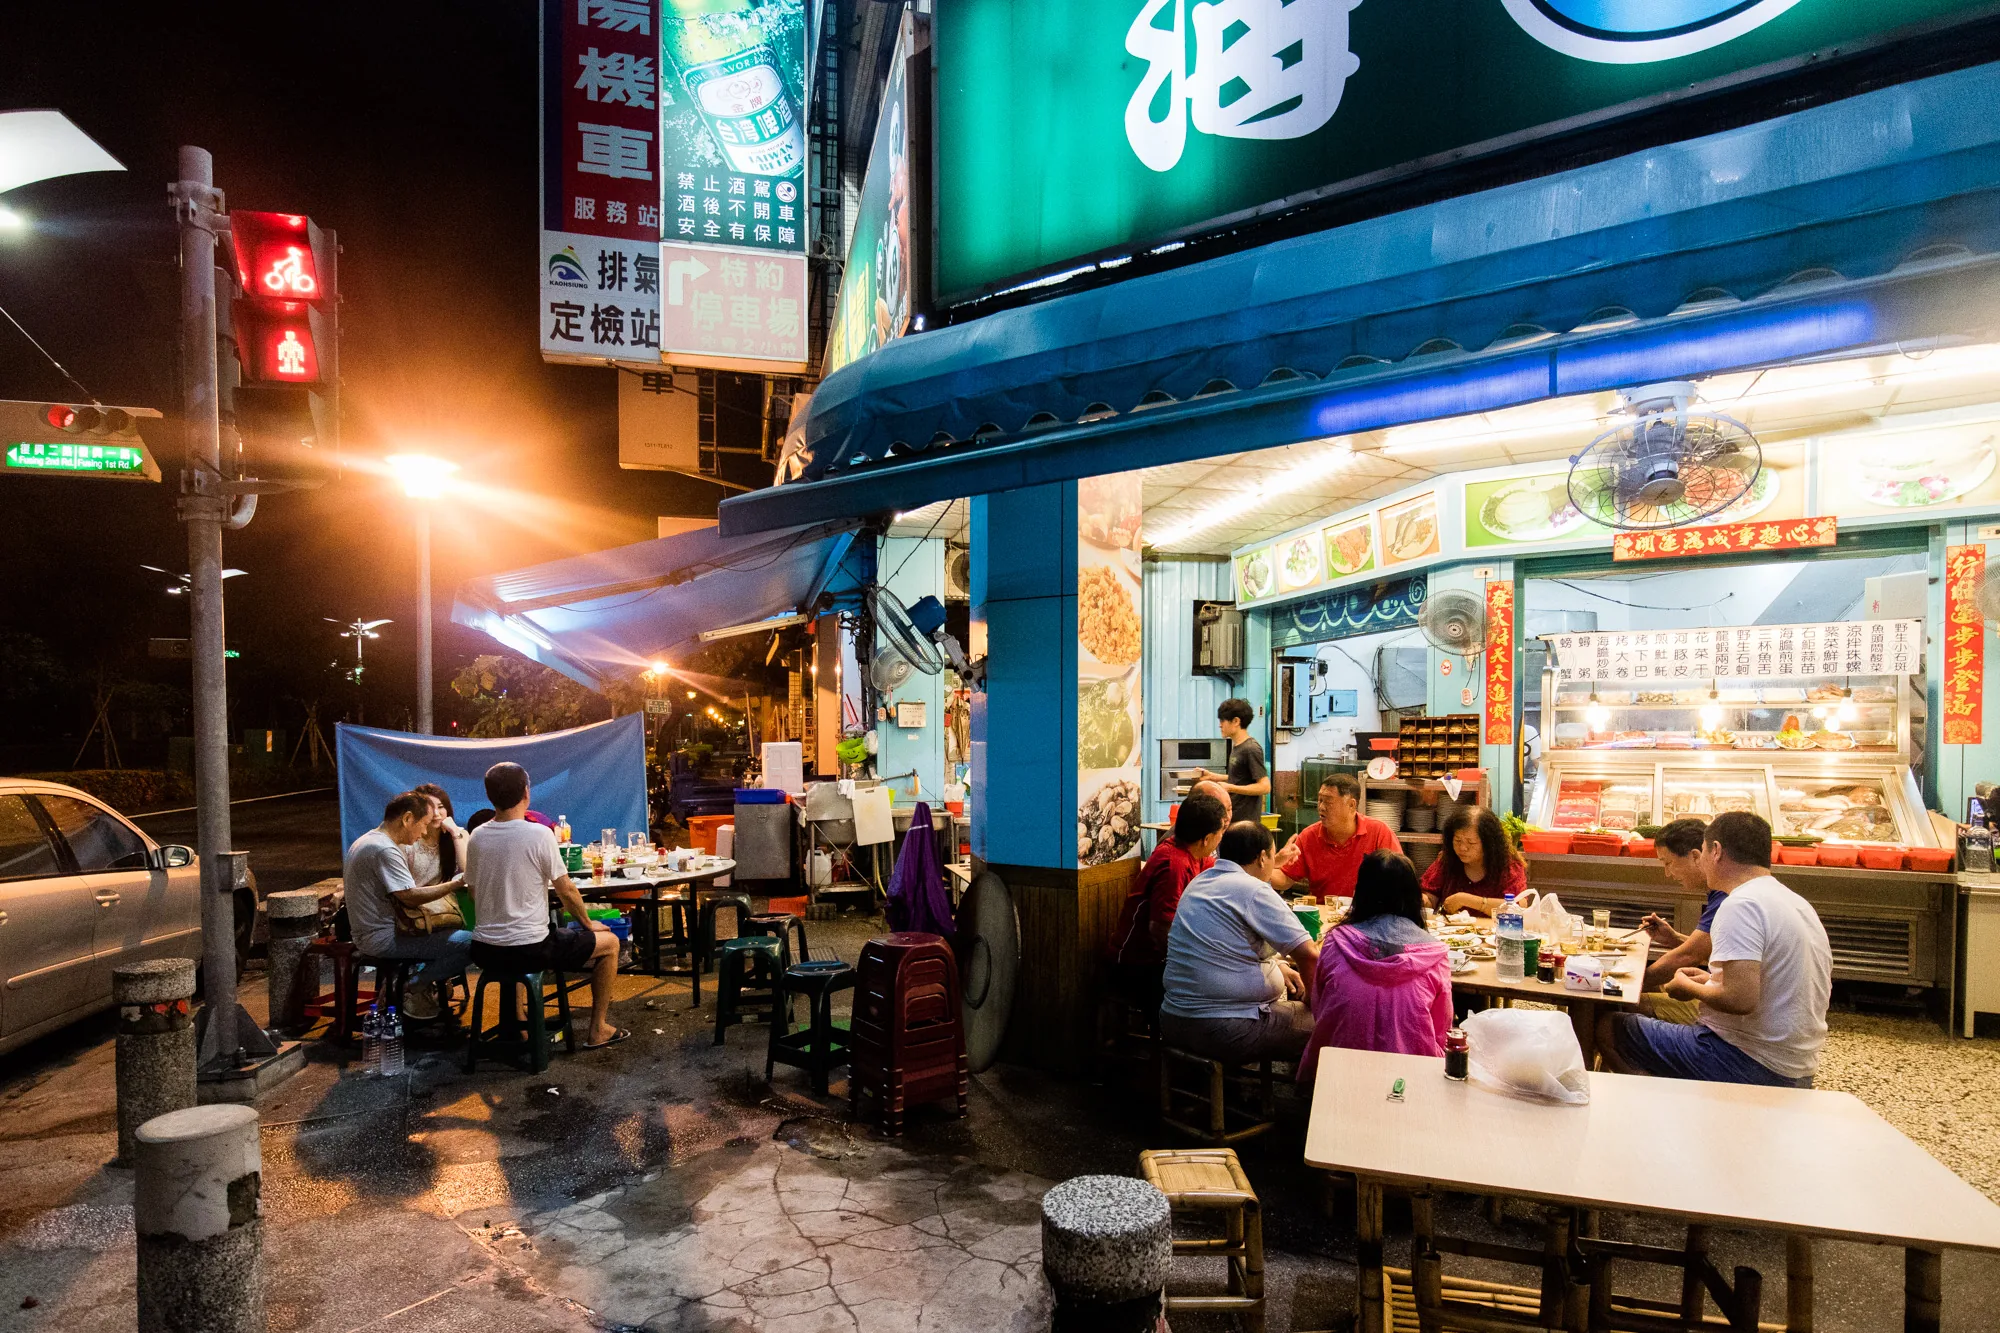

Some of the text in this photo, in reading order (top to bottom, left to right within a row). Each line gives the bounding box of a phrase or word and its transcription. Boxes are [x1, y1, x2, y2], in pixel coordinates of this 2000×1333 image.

[716, 96, 793, 143] 台灣啤酒
[748, 143, 793, 163] TAIWAN
[759, 153, 793, 171] BEER
[677, 173, 770, 198] 禁止酒駕
[574, 196, 658, 228] 服務站
[677, 194, 795, 222] 酒後不開車
[677, 217, 796, 244] 安全有保障
[549, 280, 589, 289] KAOHSIUNG
[598, 250, 660, 294] 排氣
[719, 256, 784, 291] 特約
[550, 300, 660, 350] 定檢站
[690, 291, 800, 338] 停車場
[78, 459, 102, 468] Fusing
[105, 460, 117, 468] 1st
[1560, 637, 1572, 679] 螃蟹
[1597, 636, 1609, 679] 海膽炒飯
[1616, 635, 1629, 678] 烤大卷
[1634, 635, 1648, 677] 烤下巴
[1674, 632, 1688, 676] 河豚皮
[1715, 630, 1729, 676] 龍蝦兩吃
[1736, 629, 1750, 675] 野生石蚵
[1758, 628, 1772, 675] 三杯魚舌
[1779, 627, 1794, 675] 海膽煎蛋
[1822, 626, 1839, 673] 紫菜鮮蚵
[1846, 625, 1862, 673] 涼拌珠螺
[1894, 623, 1908, 671] 野生小石斑
